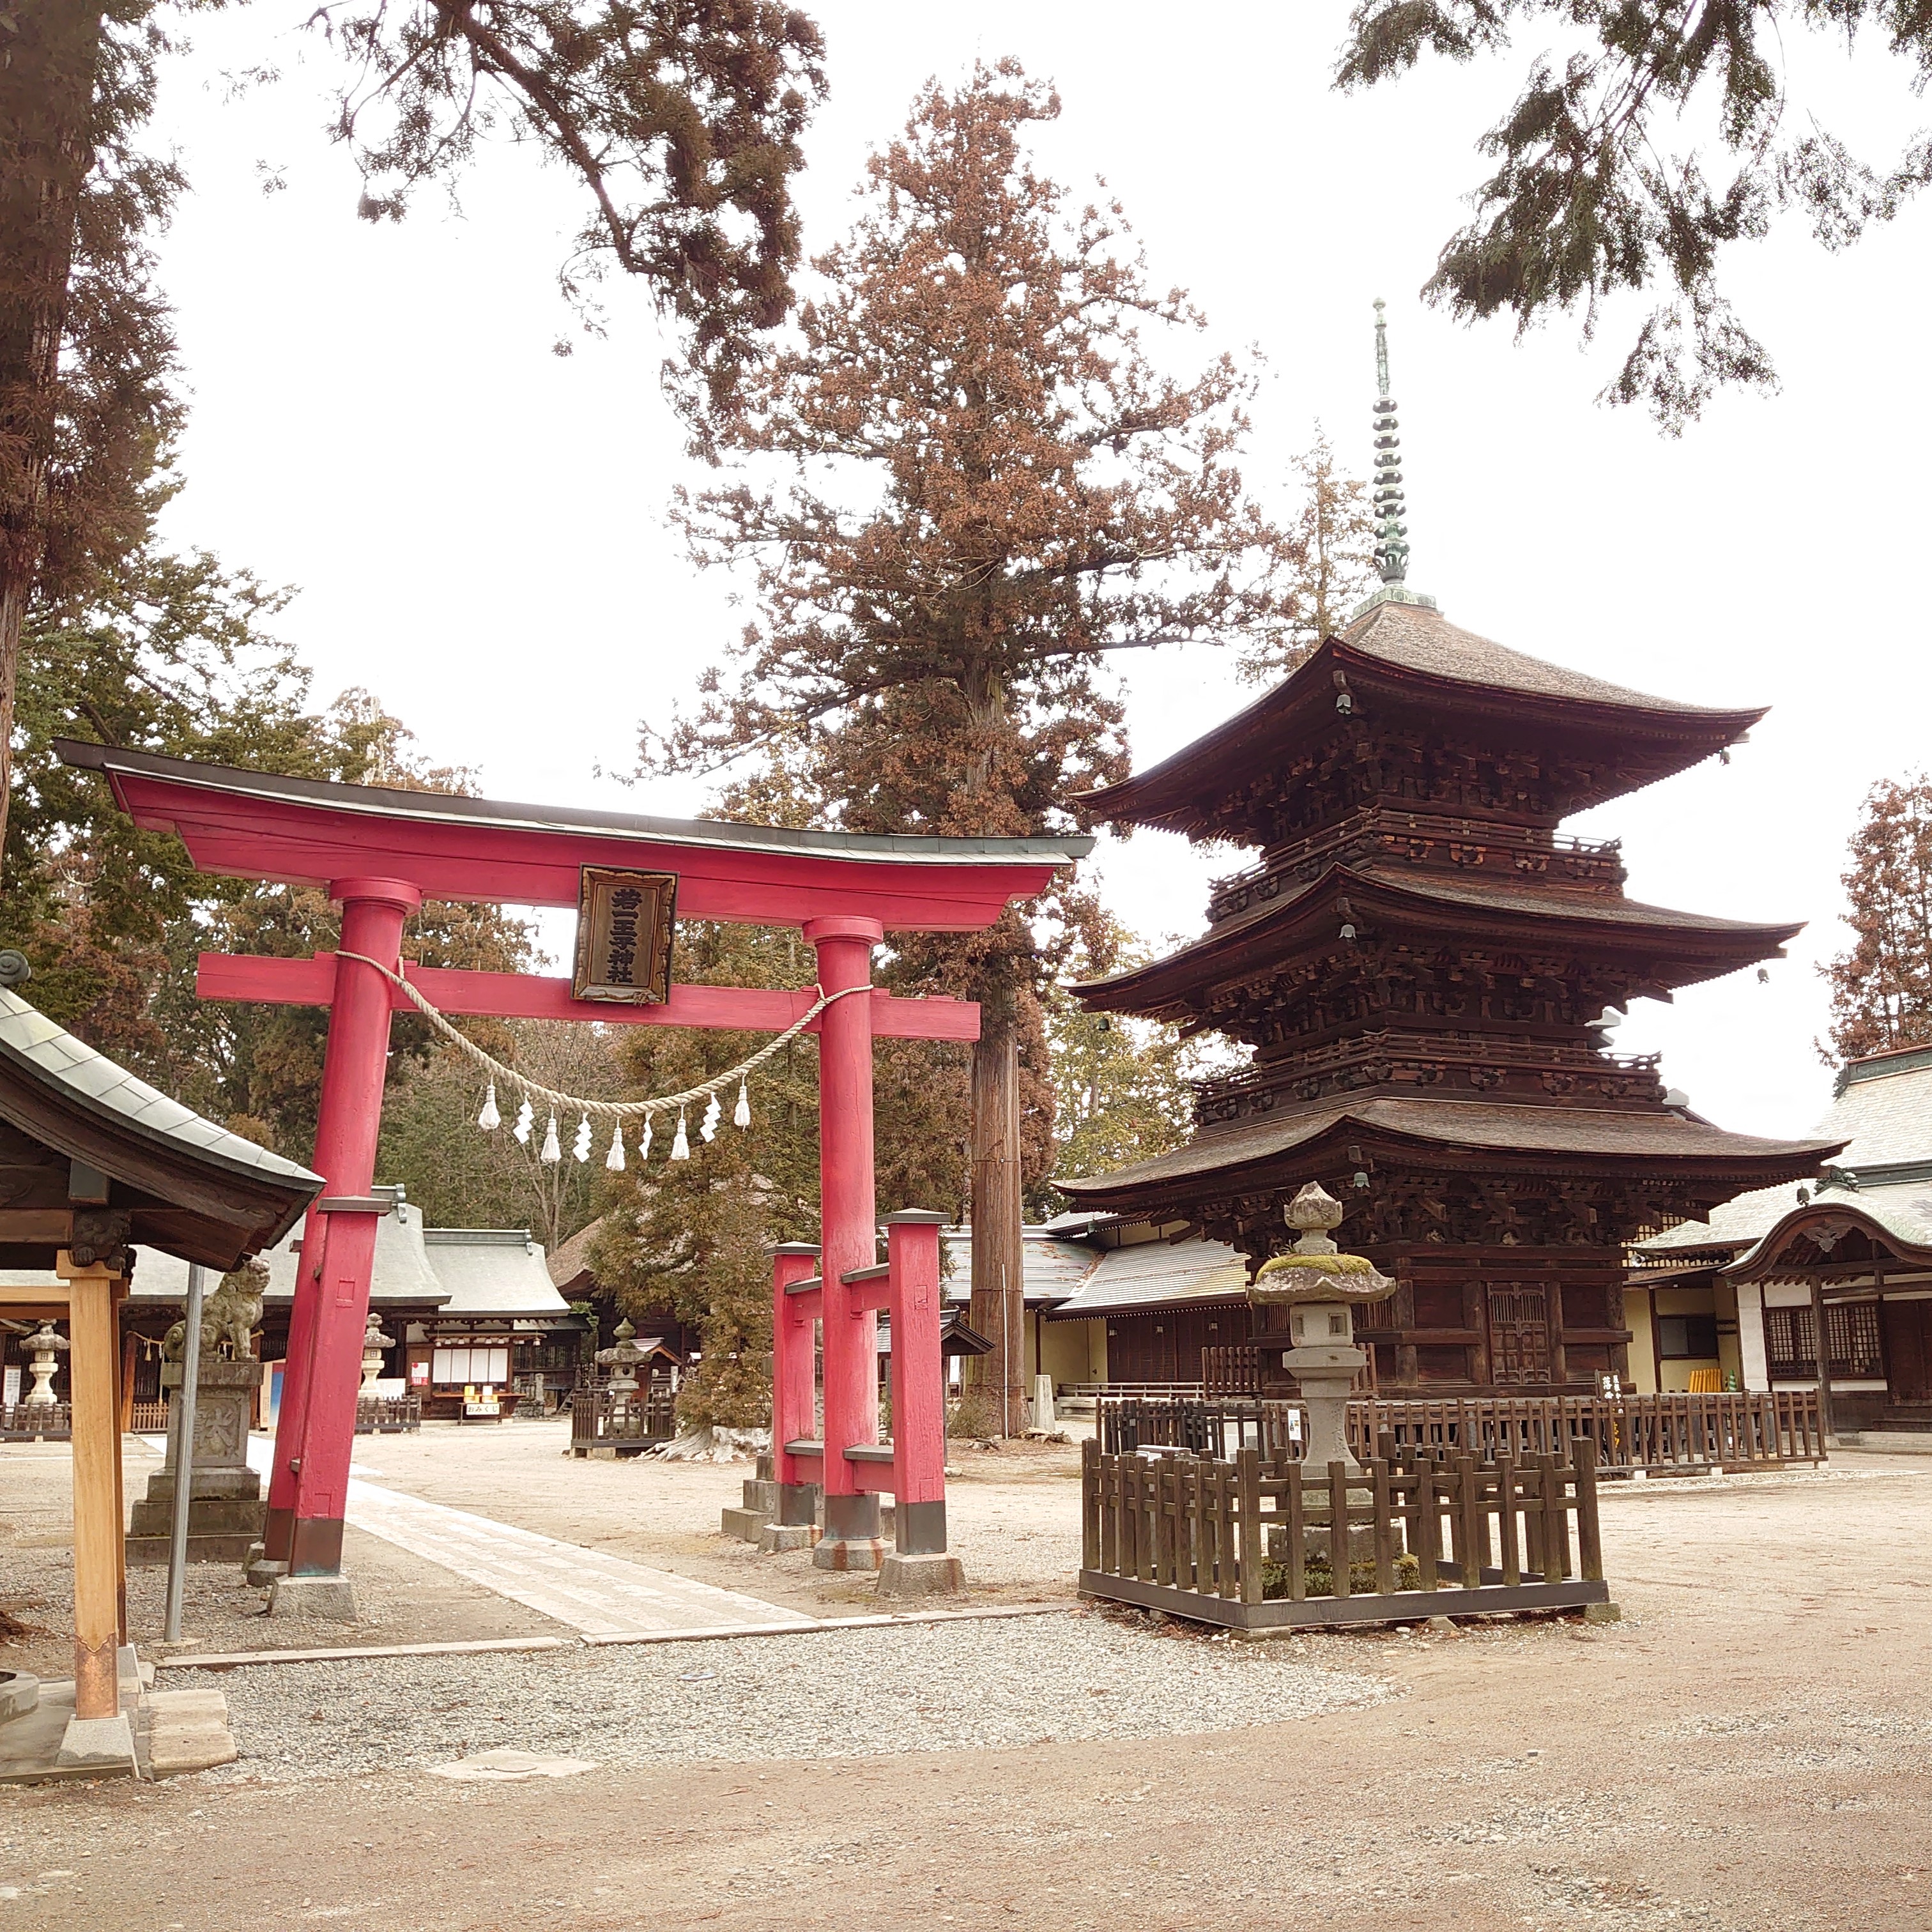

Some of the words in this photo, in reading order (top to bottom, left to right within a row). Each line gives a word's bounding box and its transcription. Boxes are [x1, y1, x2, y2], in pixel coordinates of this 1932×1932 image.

[606, 889, 643, 983] 若一王子神社
